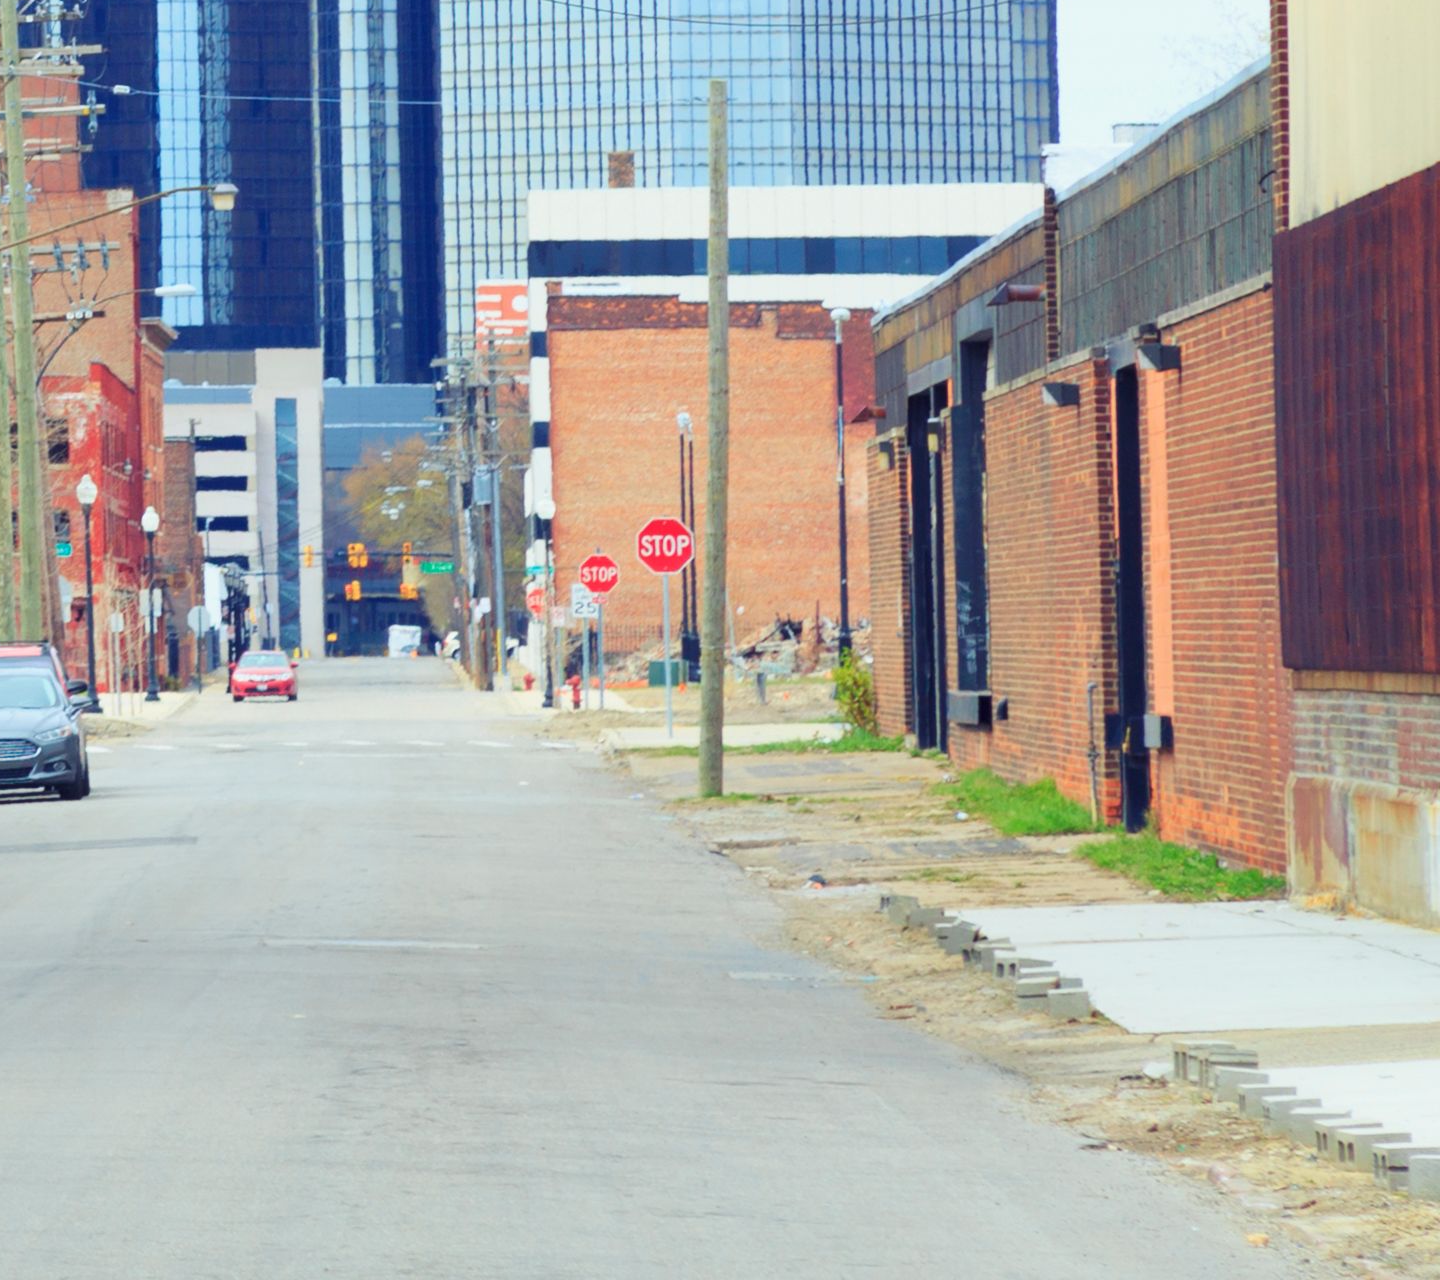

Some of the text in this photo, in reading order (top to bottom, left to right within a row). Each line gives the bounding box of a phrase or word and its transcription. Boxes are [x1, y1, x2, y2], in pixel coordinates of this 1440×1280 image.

[641, 535, 689, 556] STOP
[582, 567, 617, 582] STOP
[575, 602, 597, 614] 25
